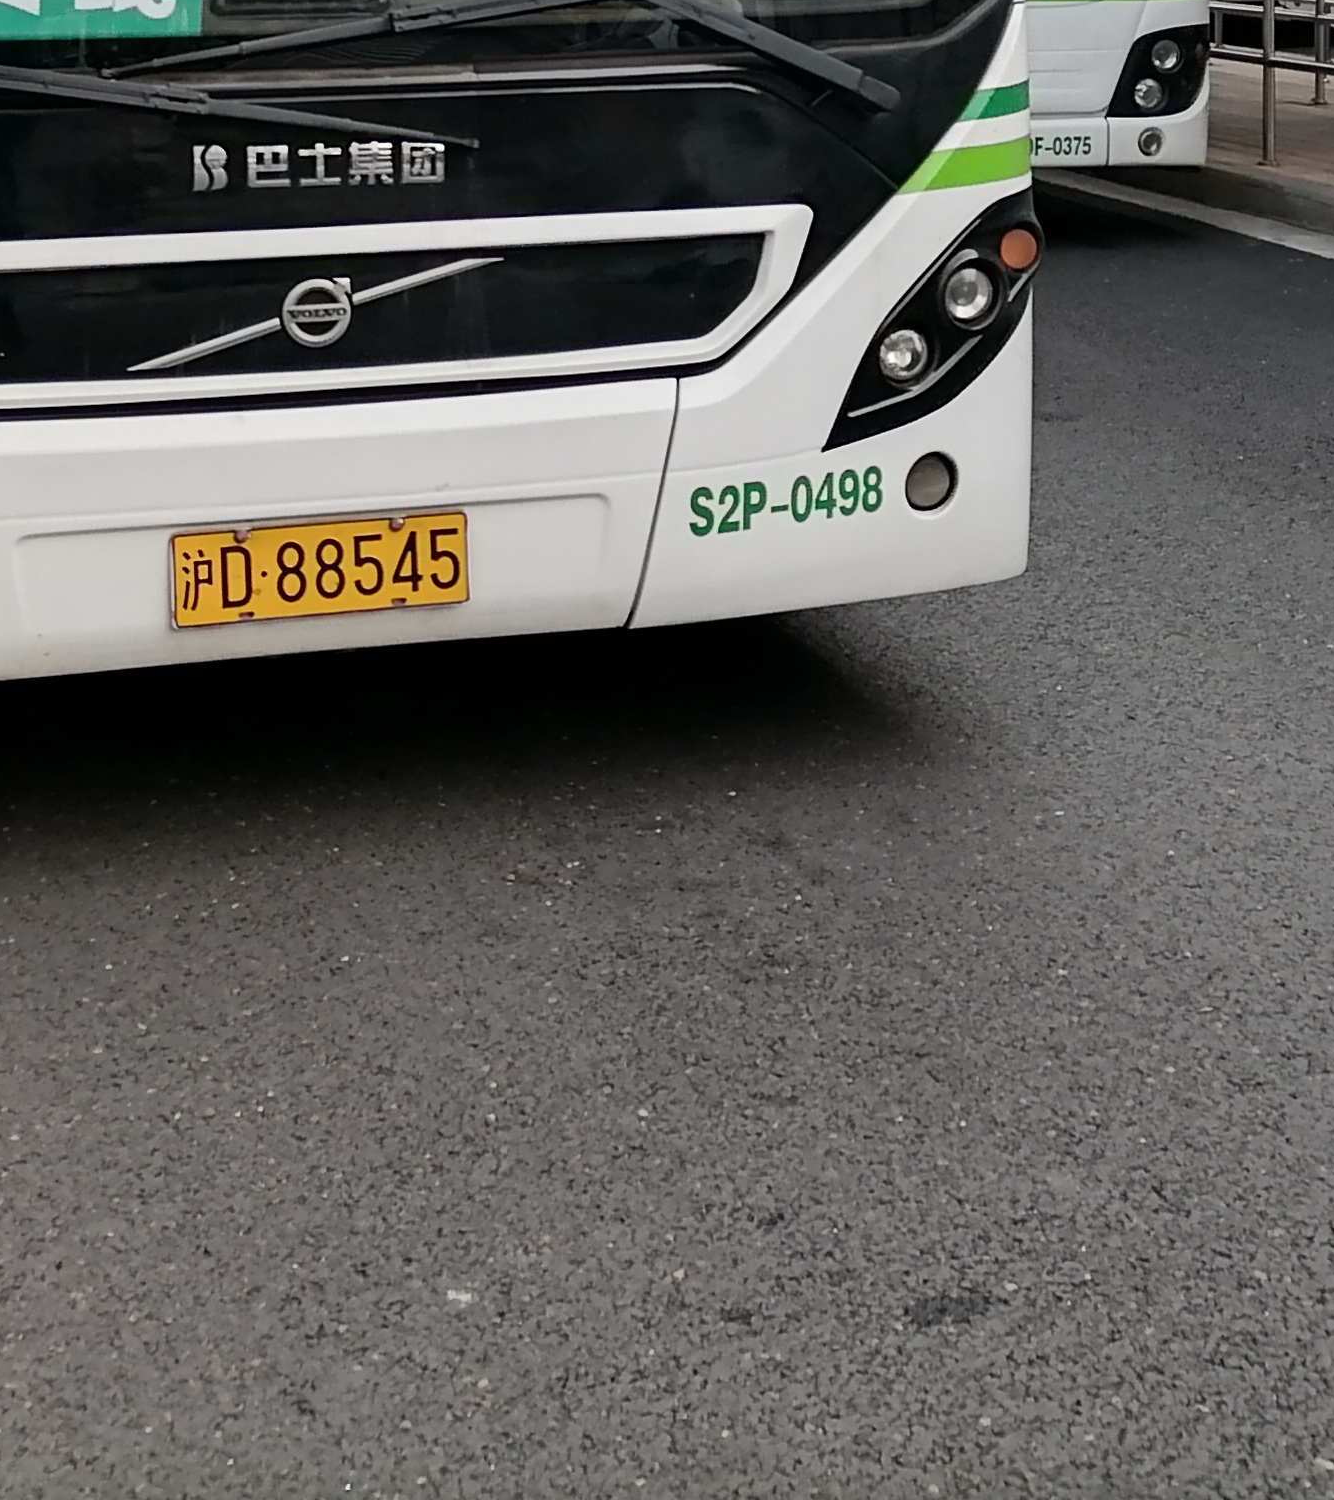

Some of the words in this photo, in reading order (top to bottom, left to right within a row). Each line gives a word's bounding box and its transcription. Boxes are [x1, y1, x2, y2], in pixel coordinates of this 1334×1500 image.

[245, 141, 446, 188] 巴士集团
[286, 307, 348, 320] VOLVO
[688, 466, 885, 537] S2P-0498
